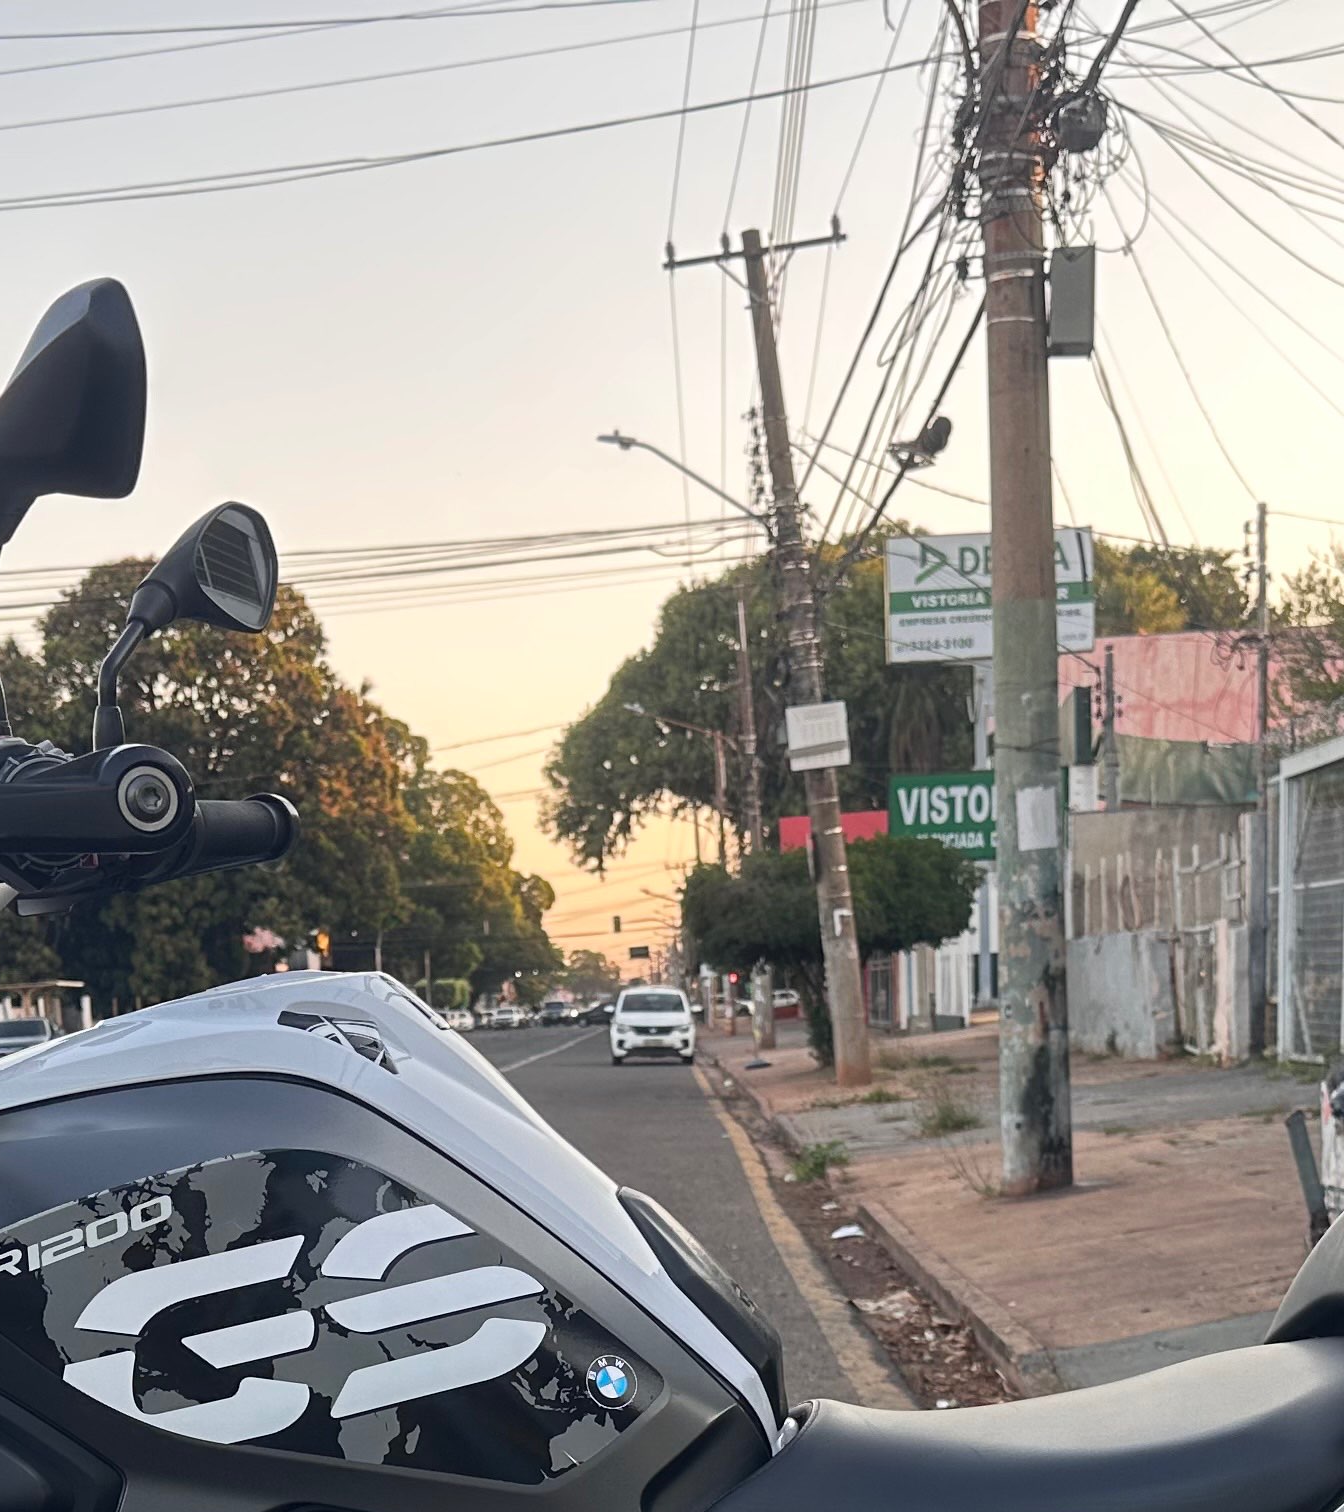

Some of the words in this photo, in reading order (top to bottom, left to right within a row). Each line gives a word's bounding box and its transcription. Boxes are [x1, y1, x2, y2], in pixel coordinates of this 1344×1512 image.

[911, 592, 986, 608] VISTORIA
[897, 783, 997, 826] VISTO
[63, 1204, 546, 1445] GS
[587, 1357, 625, 1381] BMW
